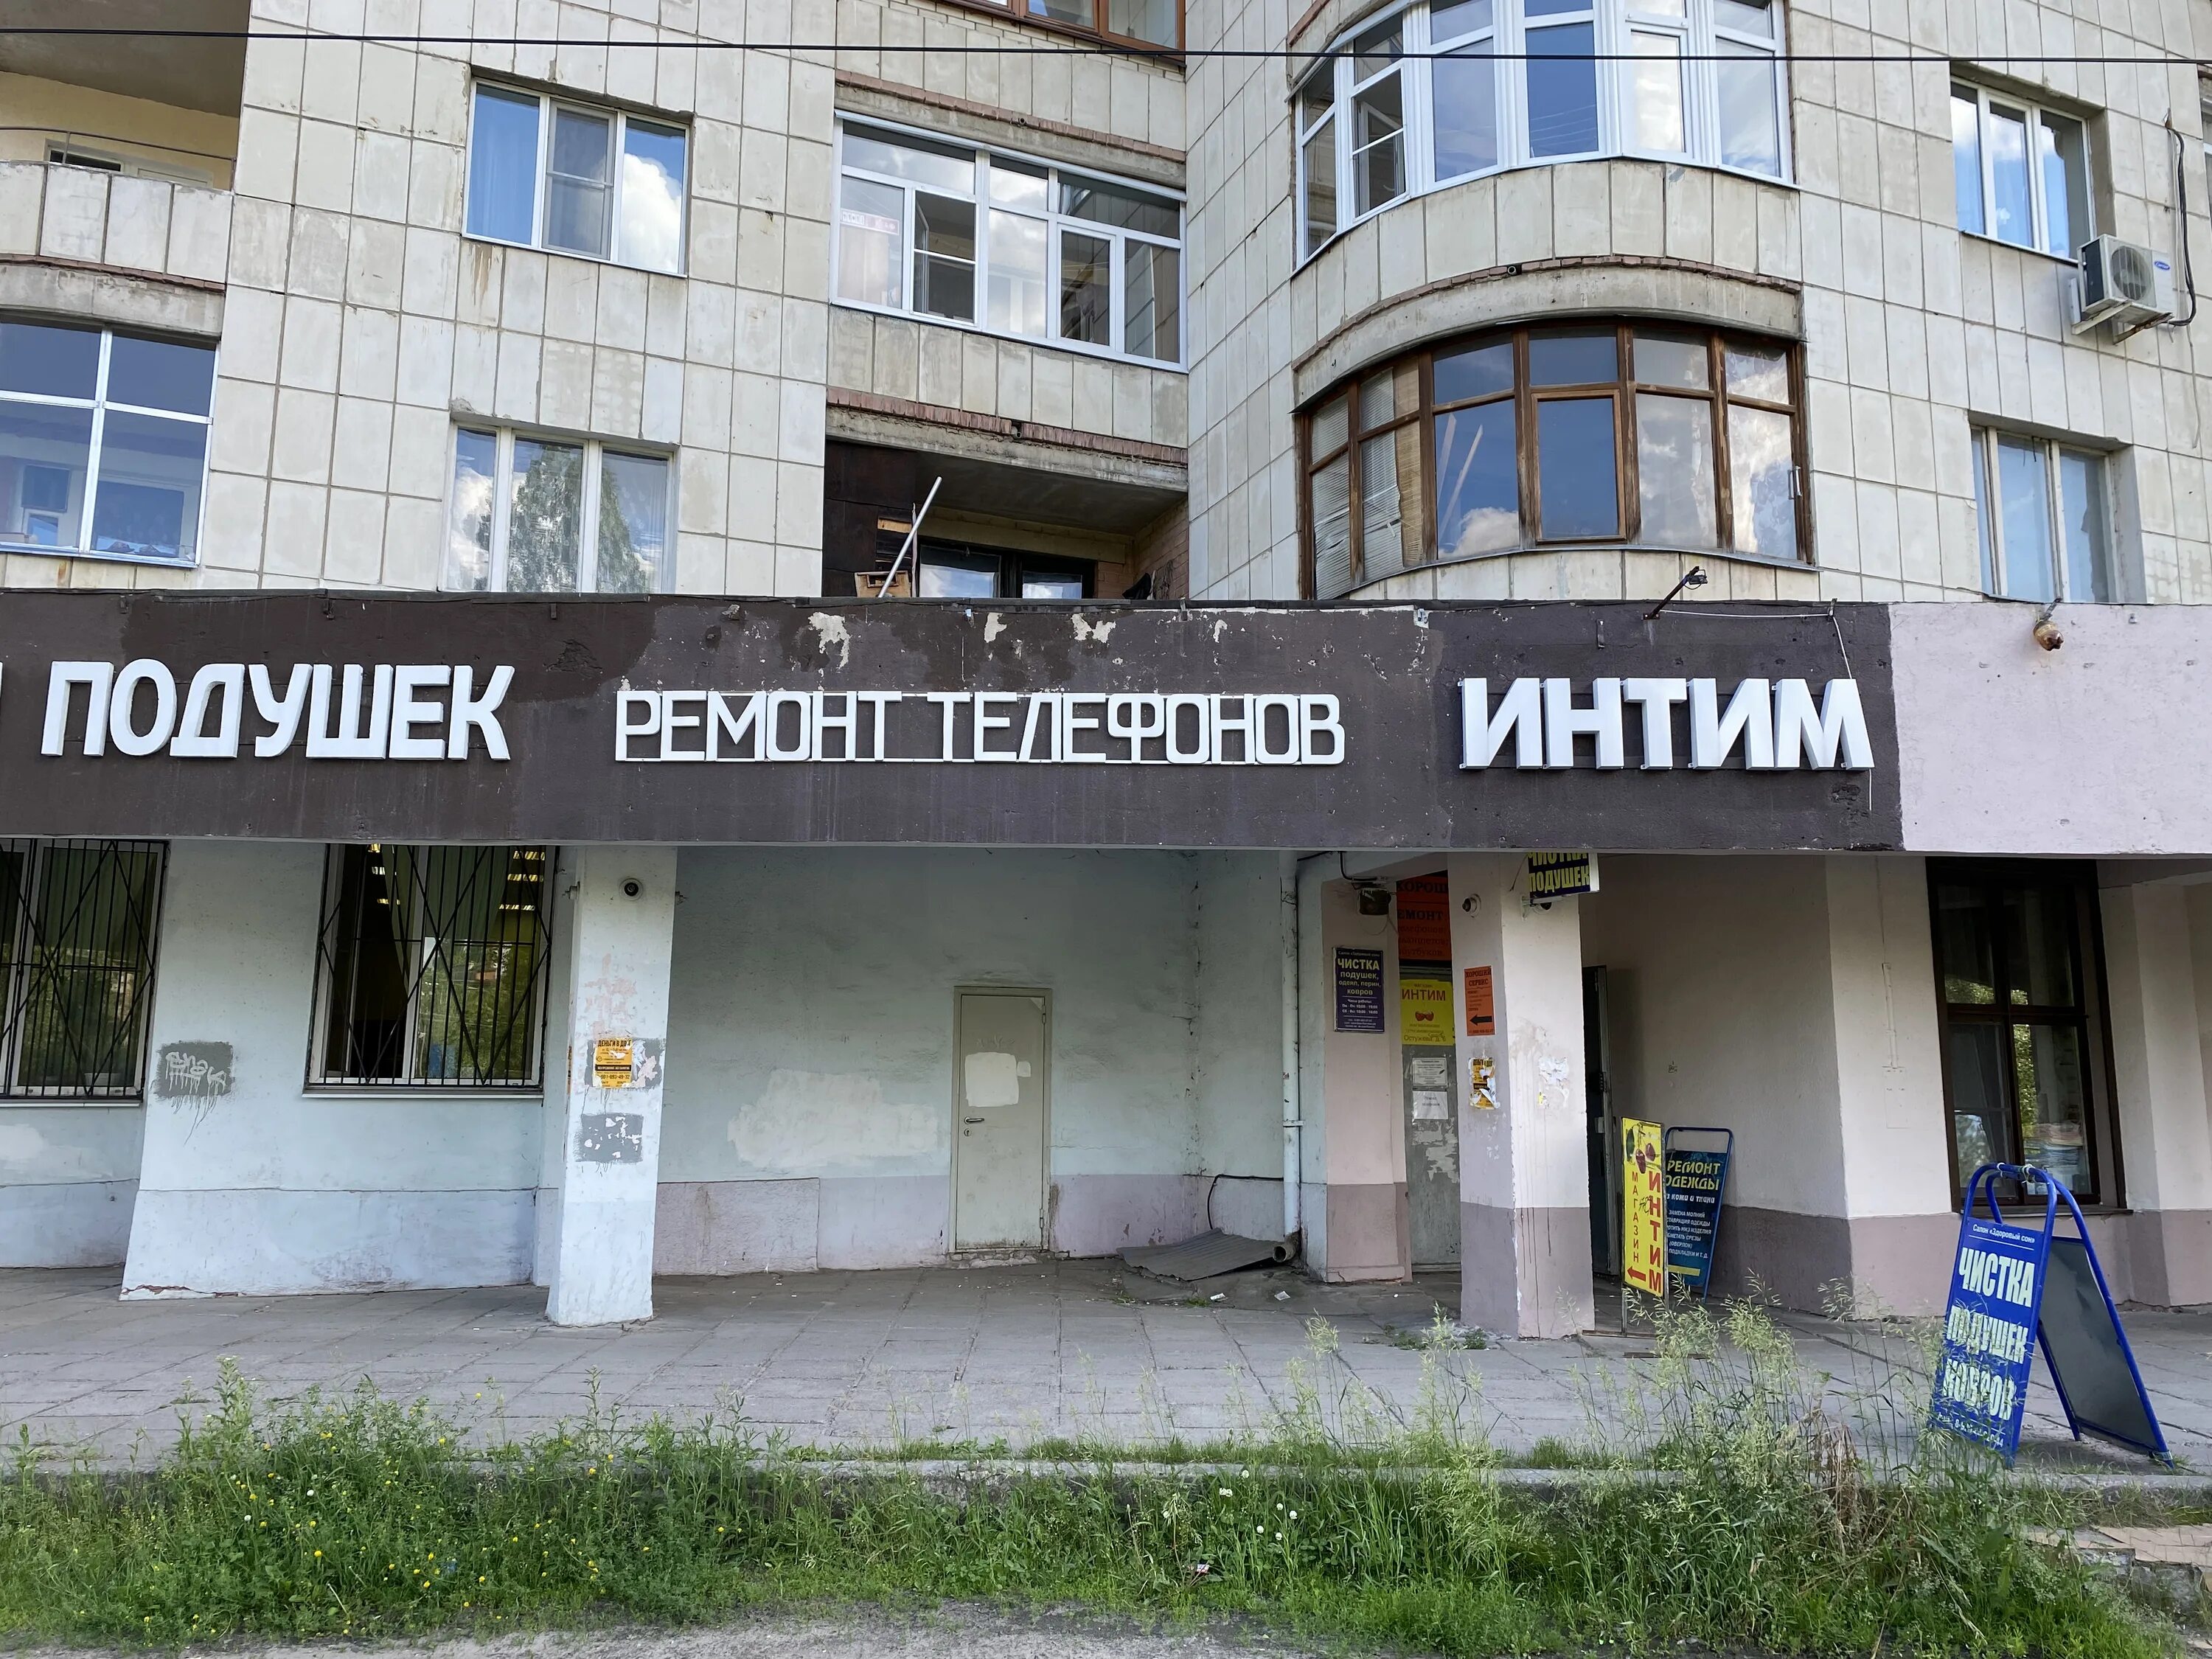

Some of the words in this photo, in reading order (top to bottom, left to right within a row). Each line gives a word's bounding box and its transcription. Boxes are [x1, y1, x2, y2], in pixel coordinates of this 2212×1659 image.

[41, 658, 515, 760] ПОДУШЕК
[615, 690, 902, 762] РЕМОНТ
[927, 691, 1345, 765] ТЕЛЕФОНОВ
[1460, 677, 1875, 771] ИНТИМ
[1529, 865, 1590, 893] ПОДУШЕК
[1338, 958, 1380, 970] ЧИСТКА
[1340, 971, 1379, 980] подушек,
[1402, 989, 1446, 1001] ИНТИМ
[1666, 1160, 1721, 1175] РЕМОНТ
[1665, 1175, 1719, 1190] ОДЕЖДЫ
[1648, 1170, 1662, 1294] ИНТИМ
[1972, 1224, 1989, 1234] Салон
[1989, 1228, 2020, 1240] «Здоровый
[2021, 1235, 2035, 1244] сон»
[1958, 1247, 2035, 1308] ЧИСТКА
[1947, 1304, 2028, 1364] ПОДУШЕК
